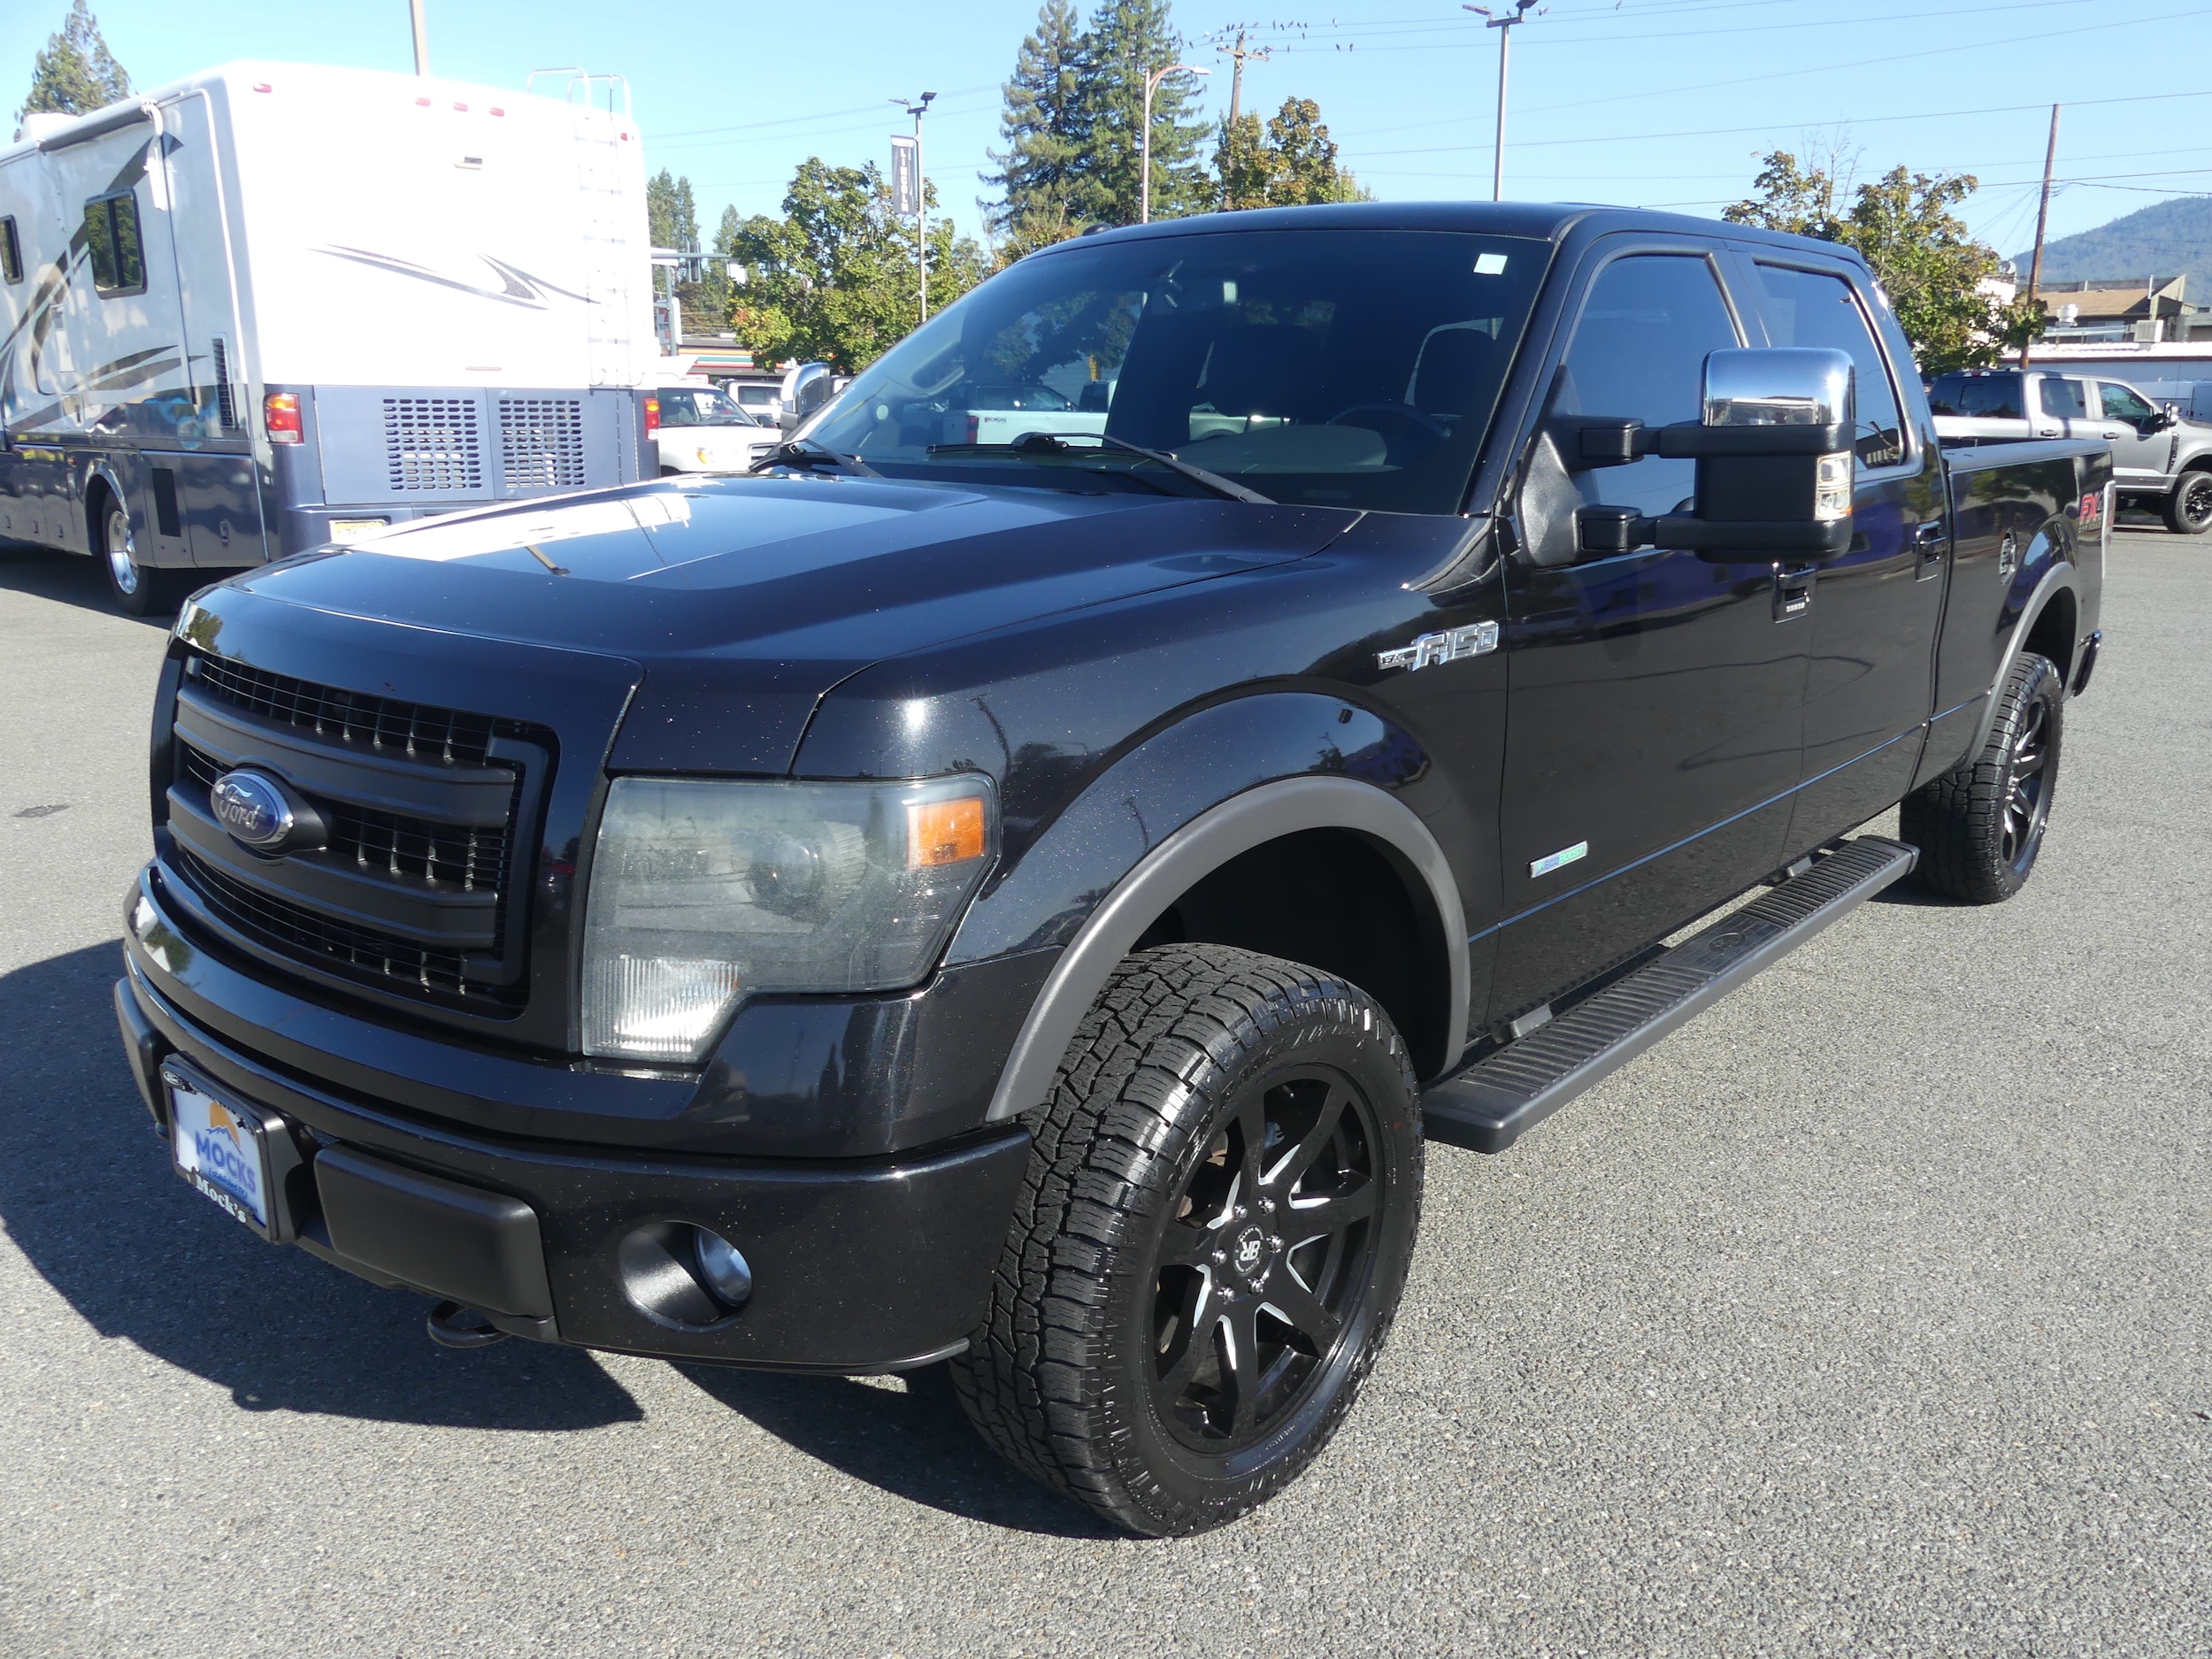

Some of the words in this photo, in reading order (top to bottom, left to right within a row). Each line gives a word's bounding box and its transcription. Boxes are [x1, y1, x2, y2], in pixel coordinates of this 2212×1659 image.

[219, 783, 260, 830] Ford
[195, 1129, 257, 1194] MOCKS
[196, 1173, 247, 1224] Mock's
